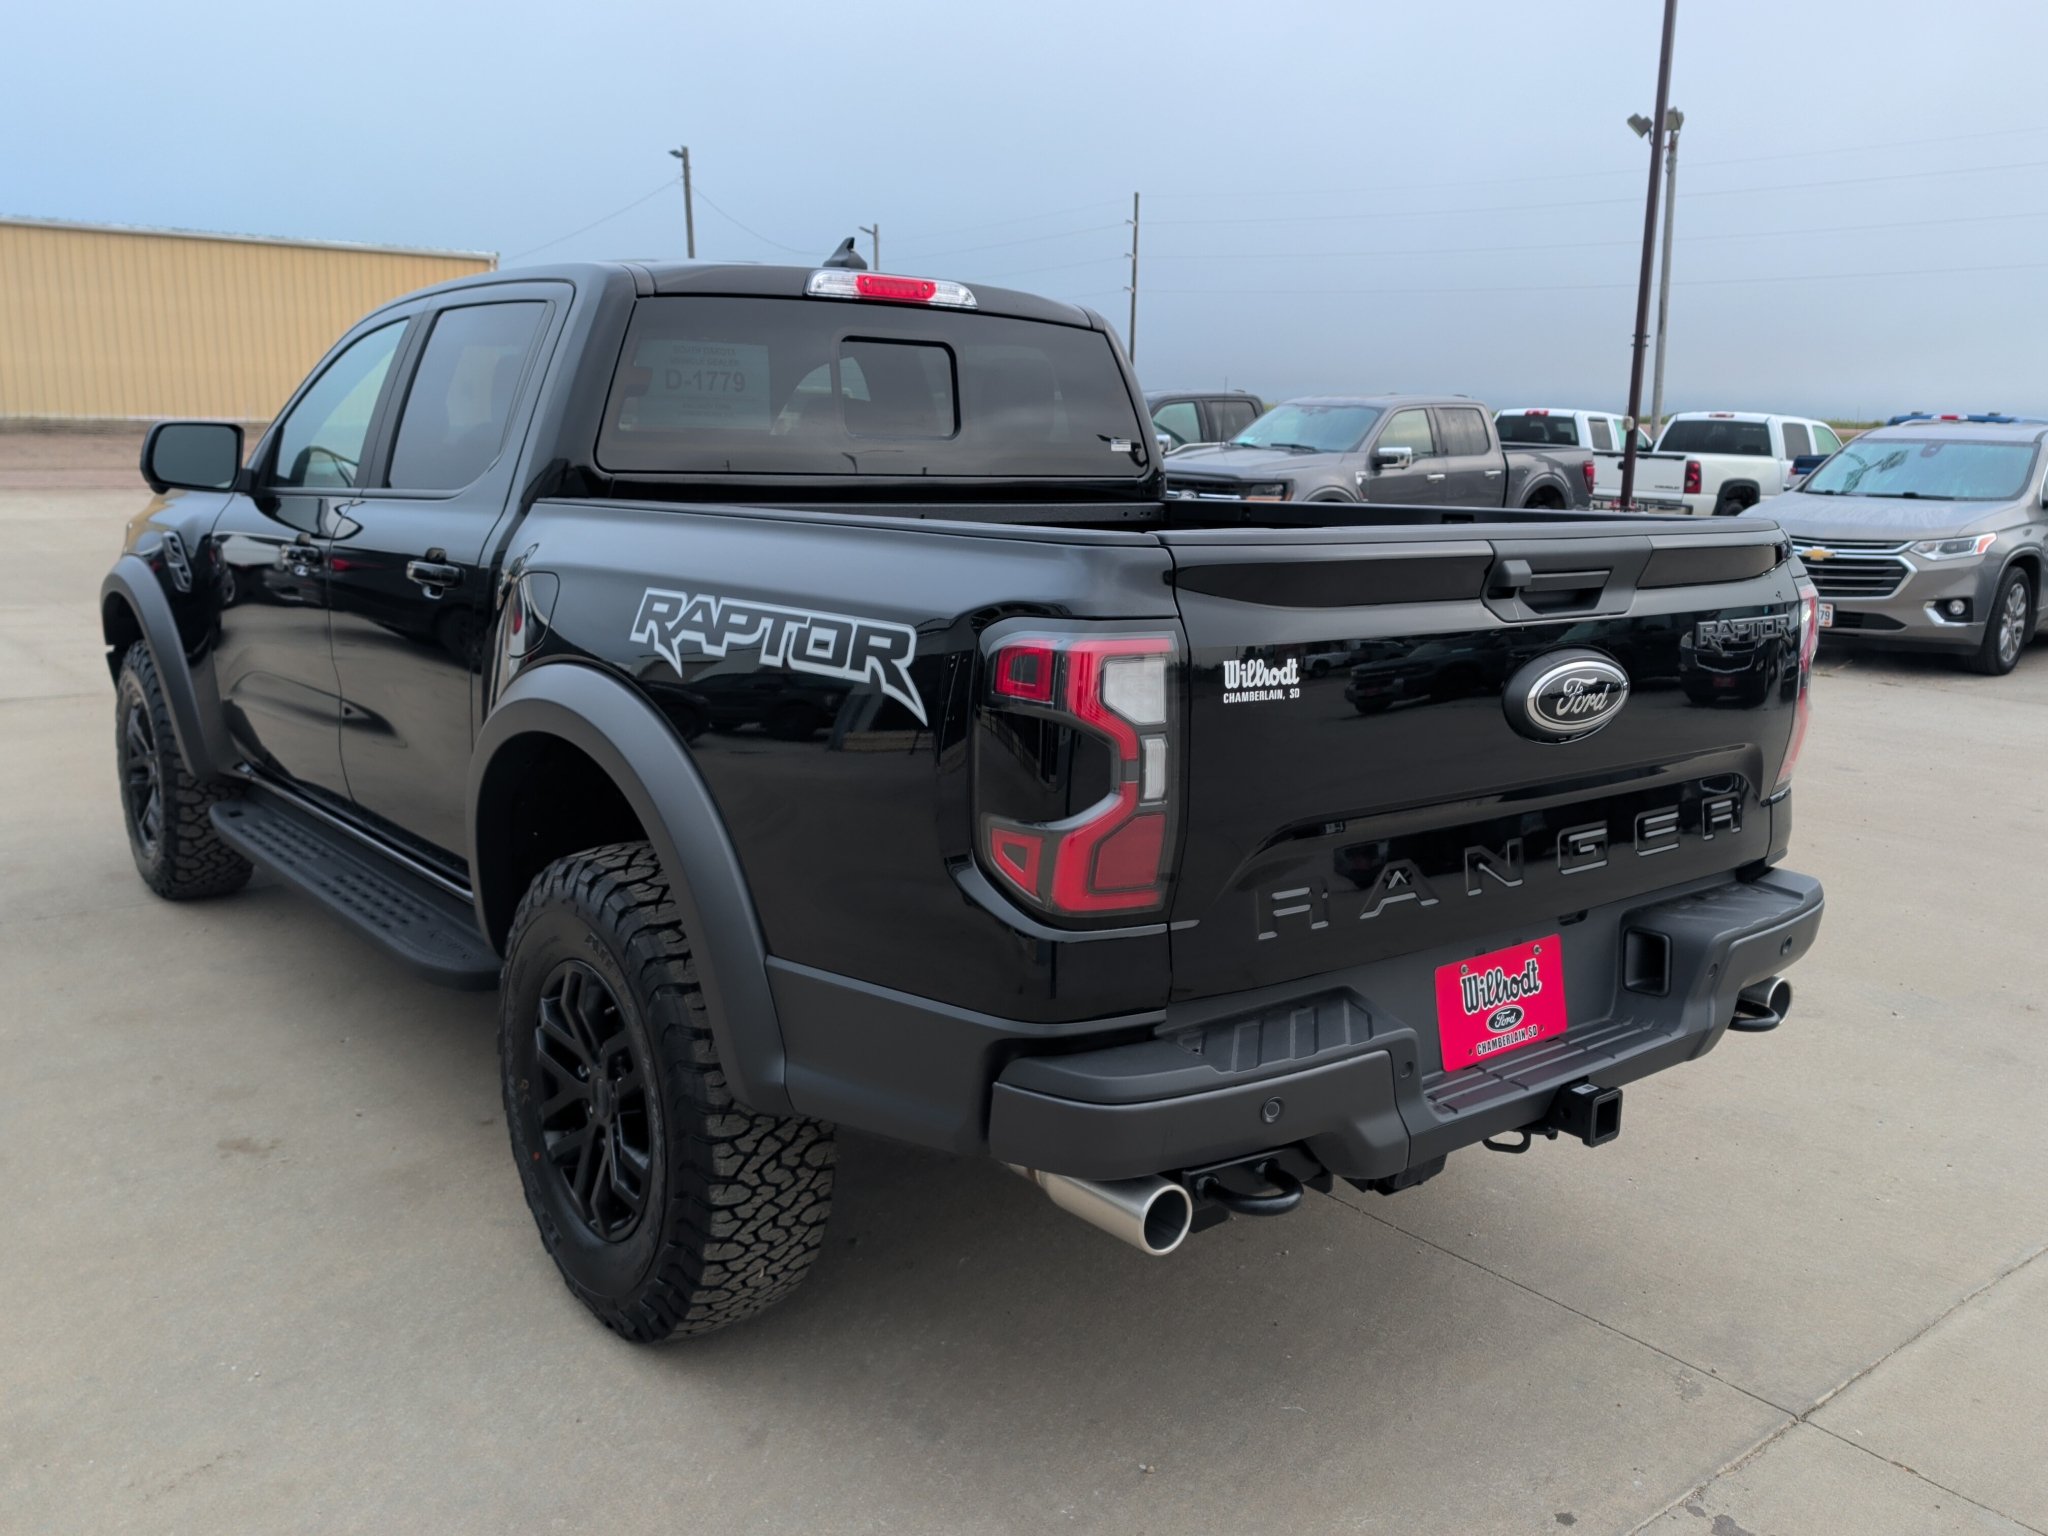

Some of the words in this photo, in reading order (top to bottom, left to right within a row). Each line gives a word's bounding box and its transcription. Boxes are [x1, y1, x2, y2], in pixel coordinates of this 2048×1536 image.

[665, 368, 746, 392] D-1779
[1696, 614, 1794, 657] RAPTOR
[629, 587, 928, 727] RAPTOR
[1223, 658, 1300, 689] Willrodt
[1223, 689, 1285, 704] CHAMBERLAIN,
[1289, 688, 1300, 699] SD
[1556, 677, 1610, 716] Ford
[1257, 795, 1743, 940] RANGER
[1460, 958, 1542, 1016] Willrodt
[1494, 1010, 1517, 1028] Ford
[1527, 1024, 1538, 1038] SD
